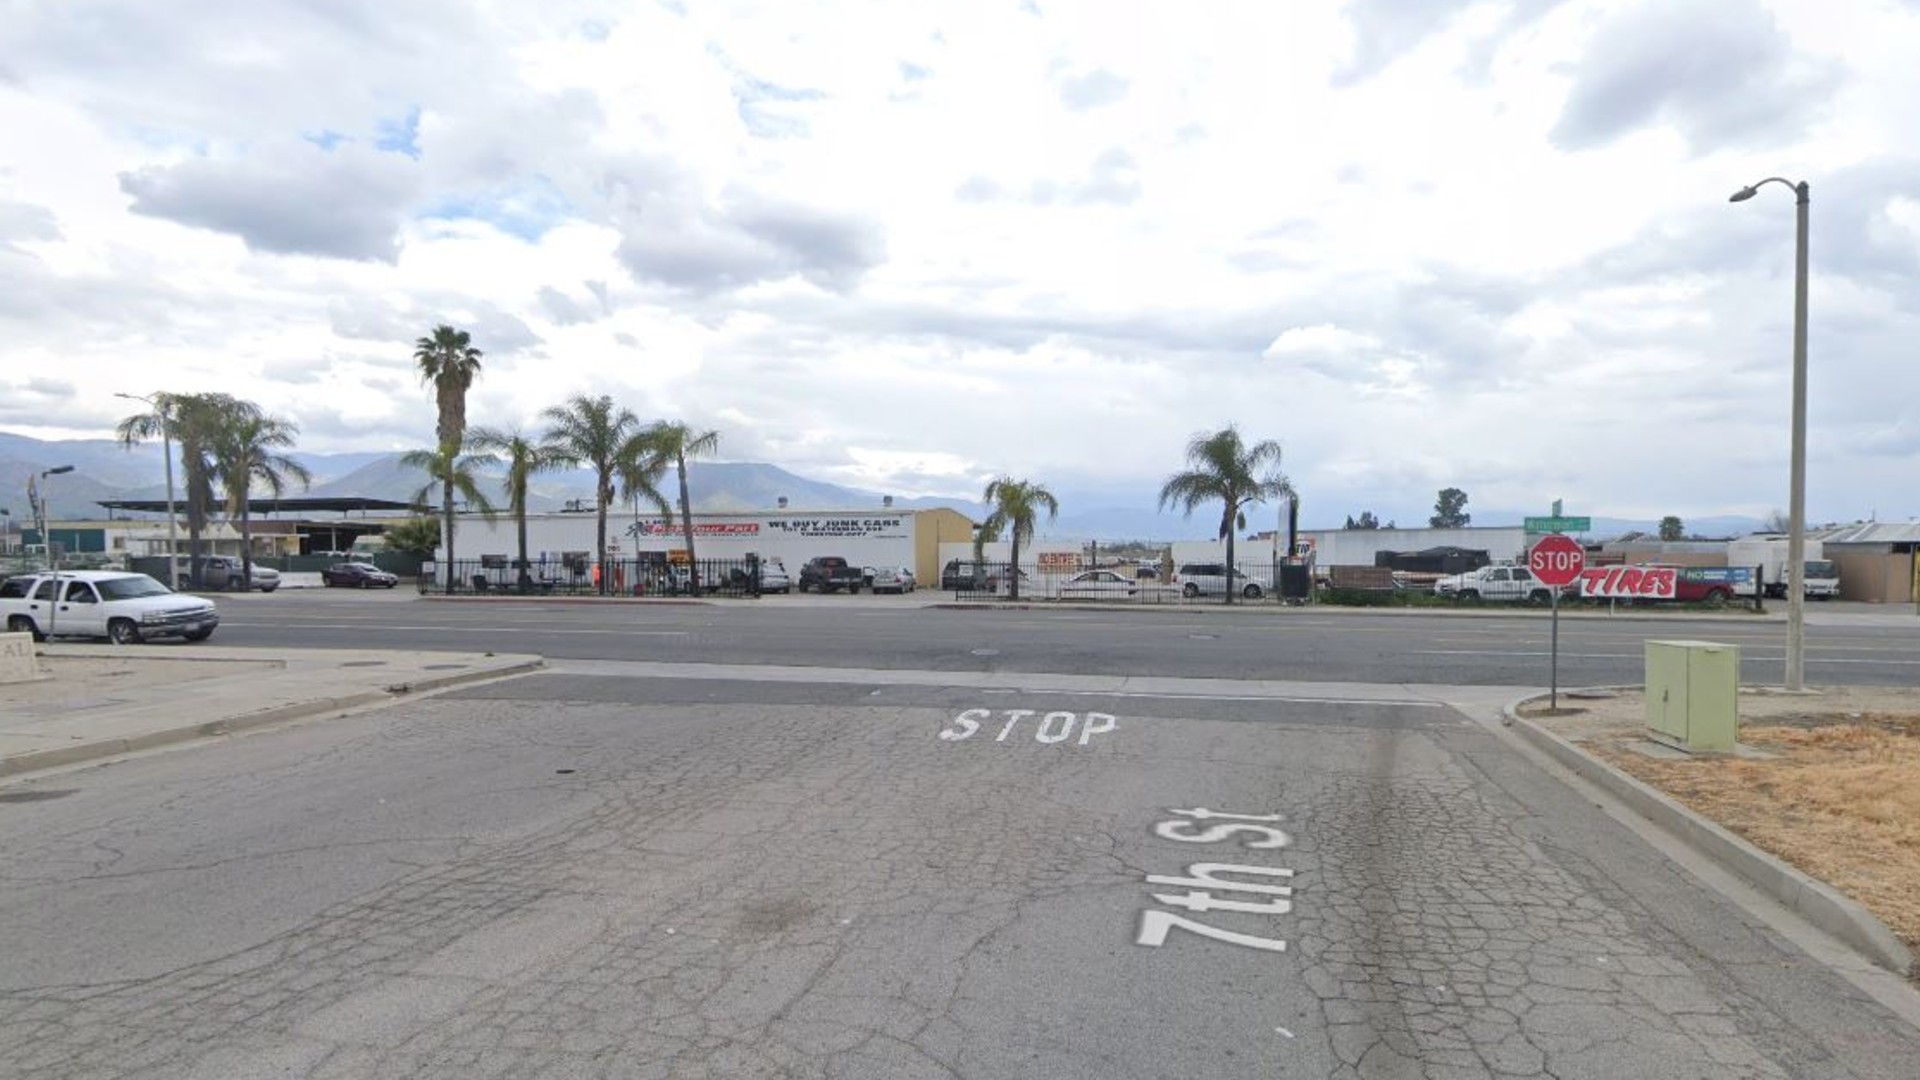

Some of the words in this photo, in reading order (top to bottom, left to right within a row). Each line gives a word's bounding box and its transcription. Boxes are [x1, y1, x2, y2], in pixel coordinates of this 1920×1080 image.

[723, 523, 758, 533] Part
[792, 520, 820, 528] BUY
[826, 519, 860, 527] JUNK
[863, 519, 900, 527] CARS
[1532, 550, 1581, 571] STOP
[1581, 567, 1675, 596] TIRES
[939, 708, 1120, 745] STOP
